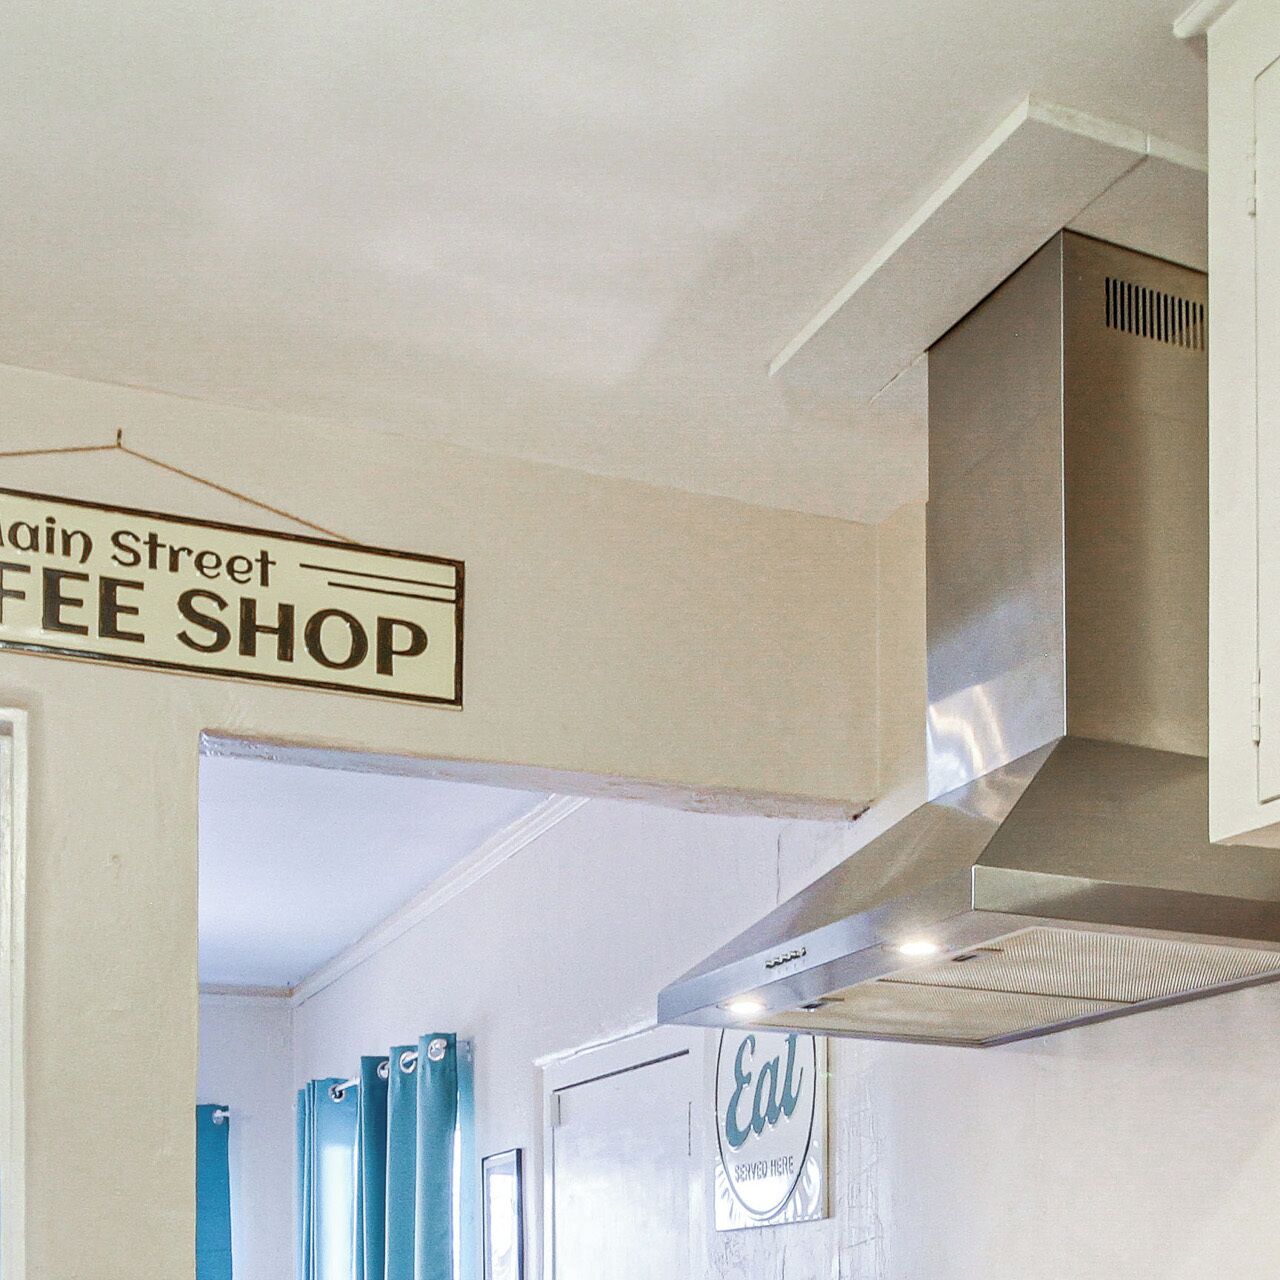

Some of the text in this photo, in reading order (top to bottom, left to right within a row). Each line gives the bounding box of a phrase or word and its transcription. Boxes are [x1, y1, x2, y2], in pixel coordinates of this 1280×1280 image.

[110, 529, 276, 588] Street
[176, 588, 429, 677] SHOP
[725, 1034, 804, 1149] Eat
[734, 1155, 794, 1183] SERVED HERE
